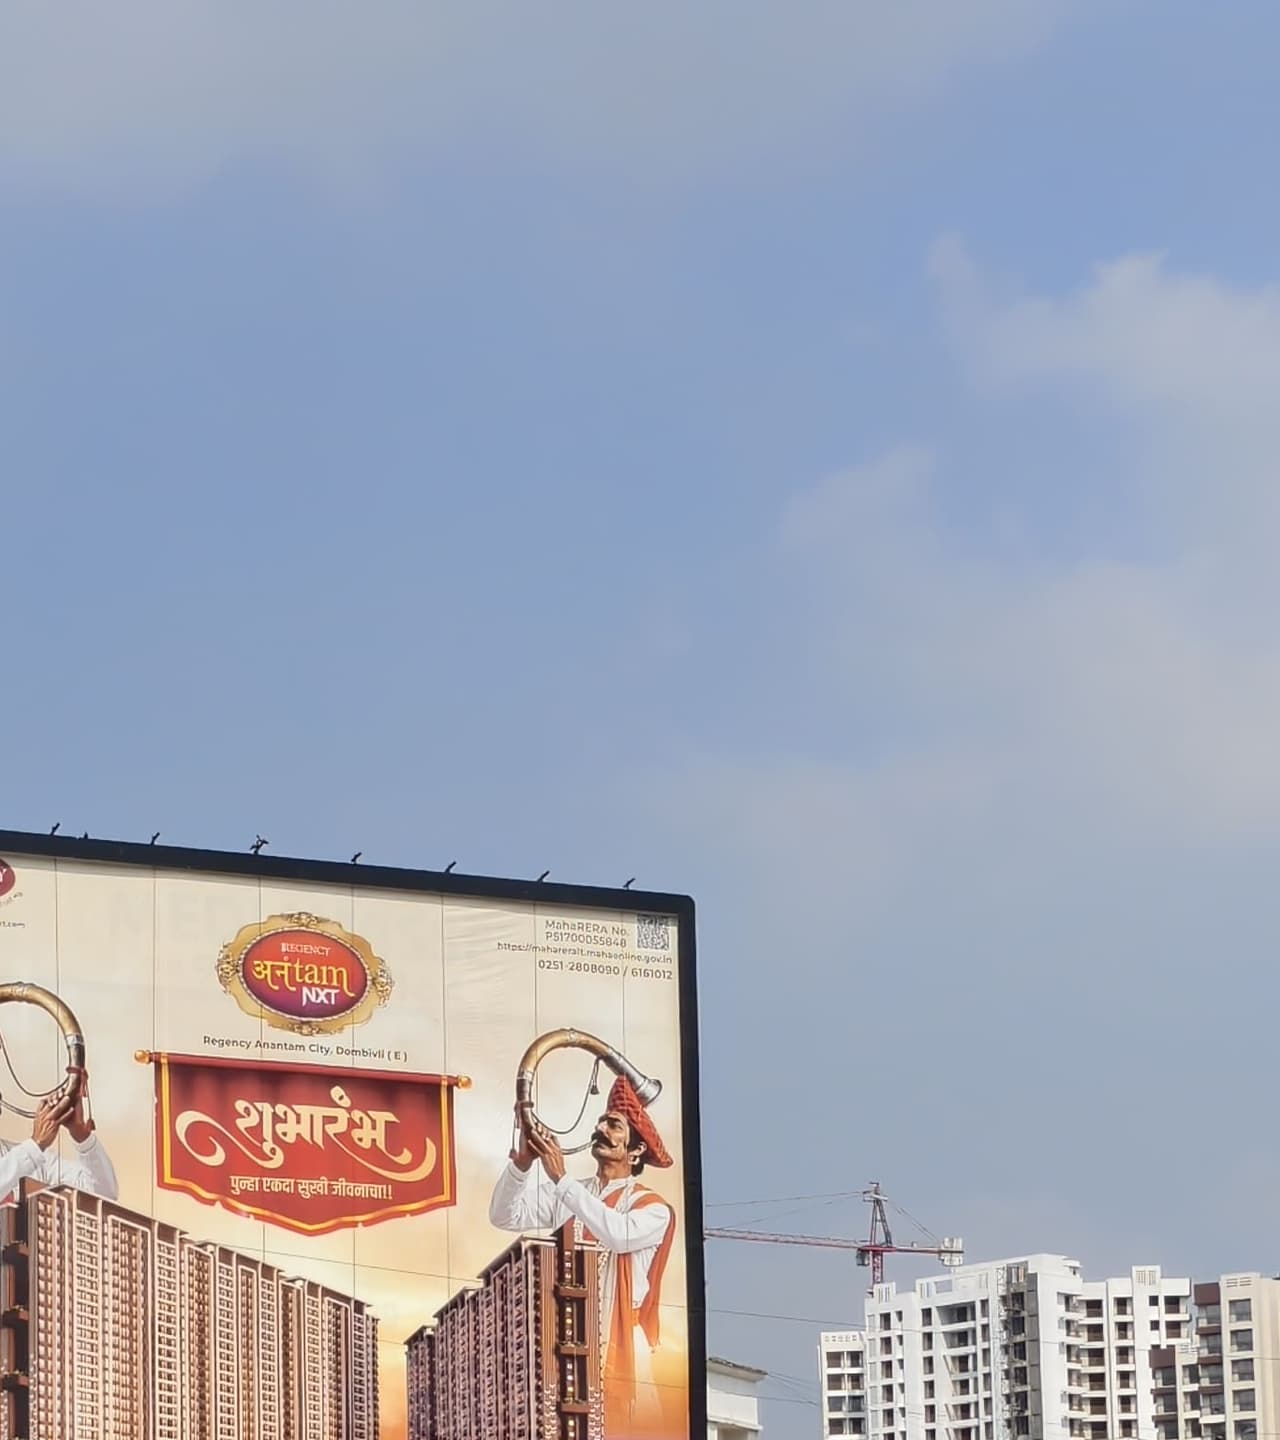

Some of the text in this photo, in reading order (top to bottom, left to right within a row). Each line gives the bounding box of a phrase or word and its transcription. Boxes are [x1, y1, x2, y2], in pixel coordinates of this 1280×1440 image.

[545, 919, 608, 935] MahaRERA
[301, 985, 341, 1007] NXT
[203, 1035, 252, 1051] Regency
[254, 1038, 306, 1053] Anantam
[336, 1045, 385, 1060] Dombivli
[175, 1084, 437, 1183] शुभारंभ
[230, 1174, 259, 1196] पुन्हा
[262, 1176, 295, 1195] एकदा
[297, 1175, 329, 1199] सुखी
